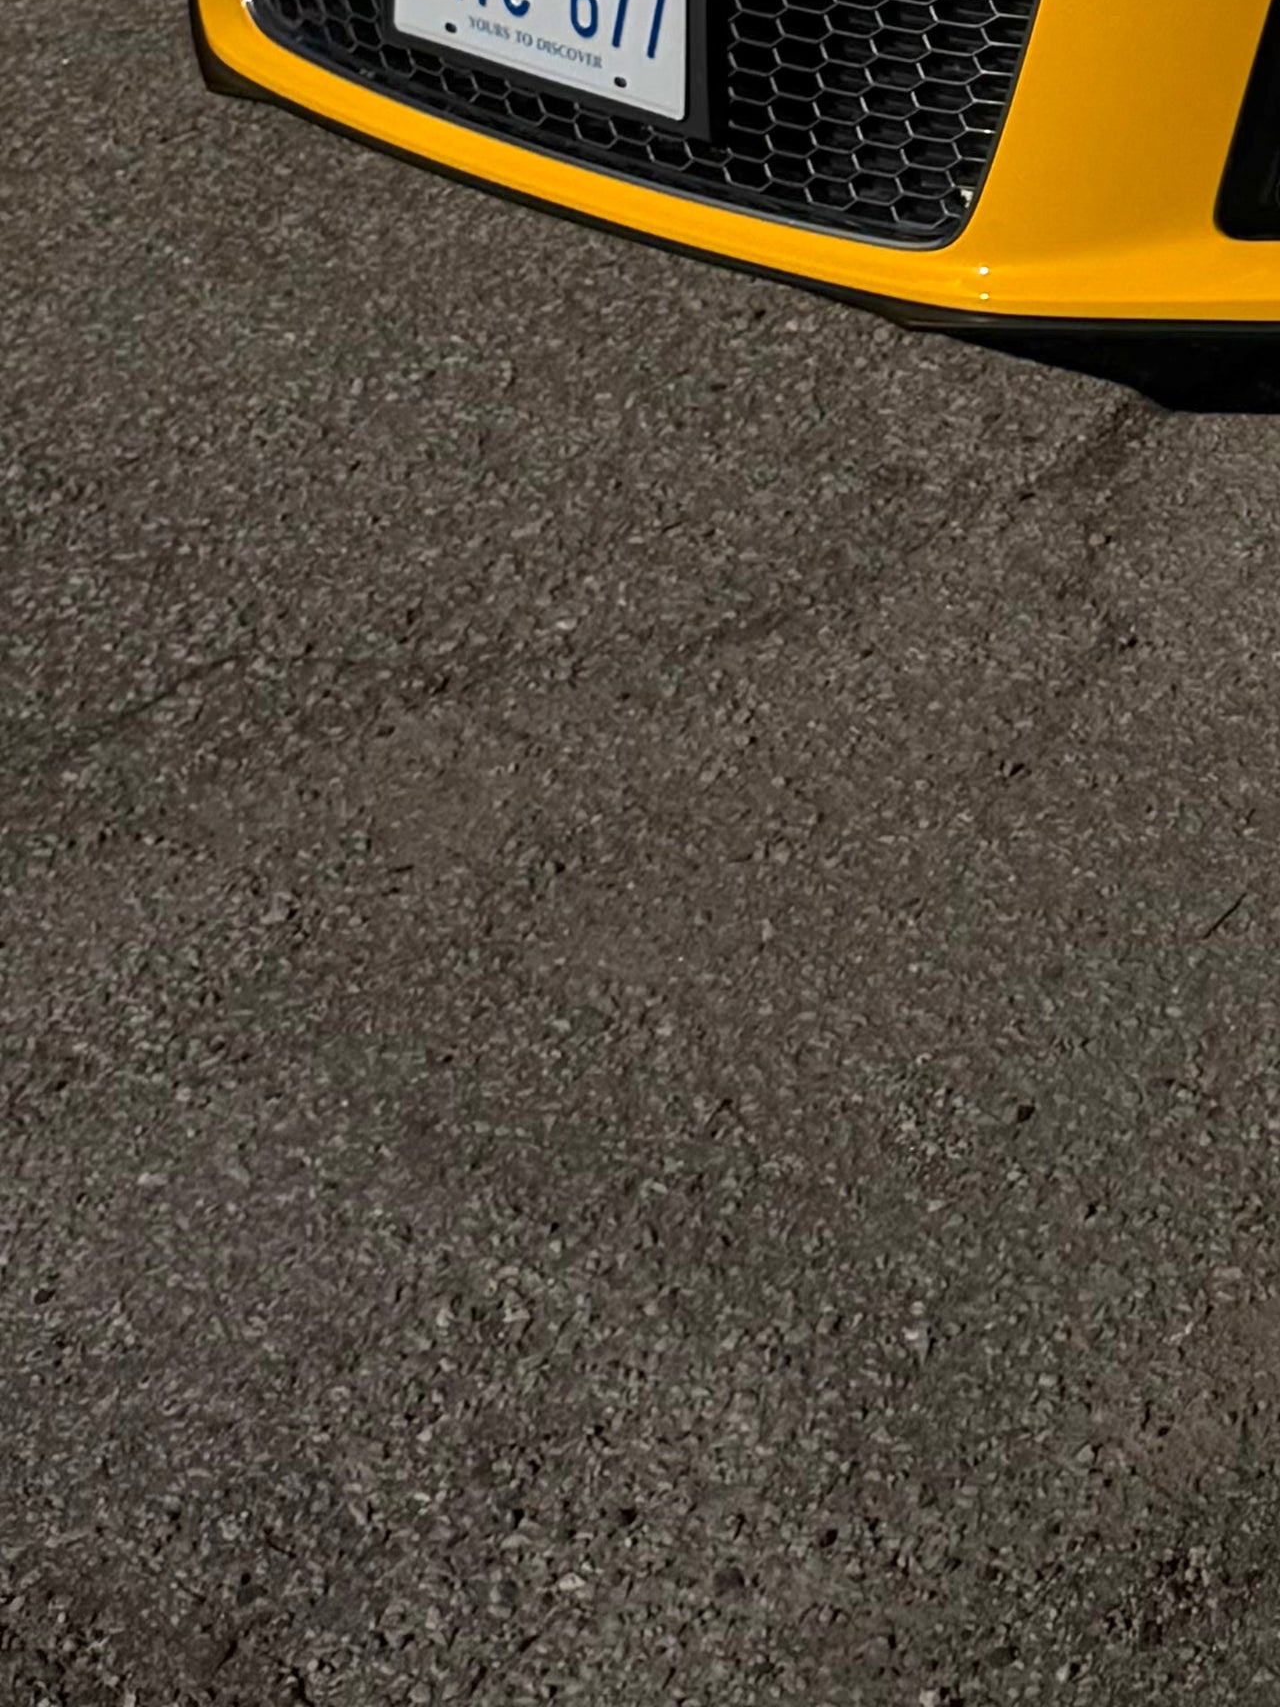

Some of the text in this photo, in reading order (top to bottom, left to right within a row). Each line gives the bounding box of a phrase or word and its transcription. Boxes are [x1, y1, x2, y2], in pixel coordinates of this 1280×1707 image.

[467, 15, 604, 70] YOURS TO DISCOVER
